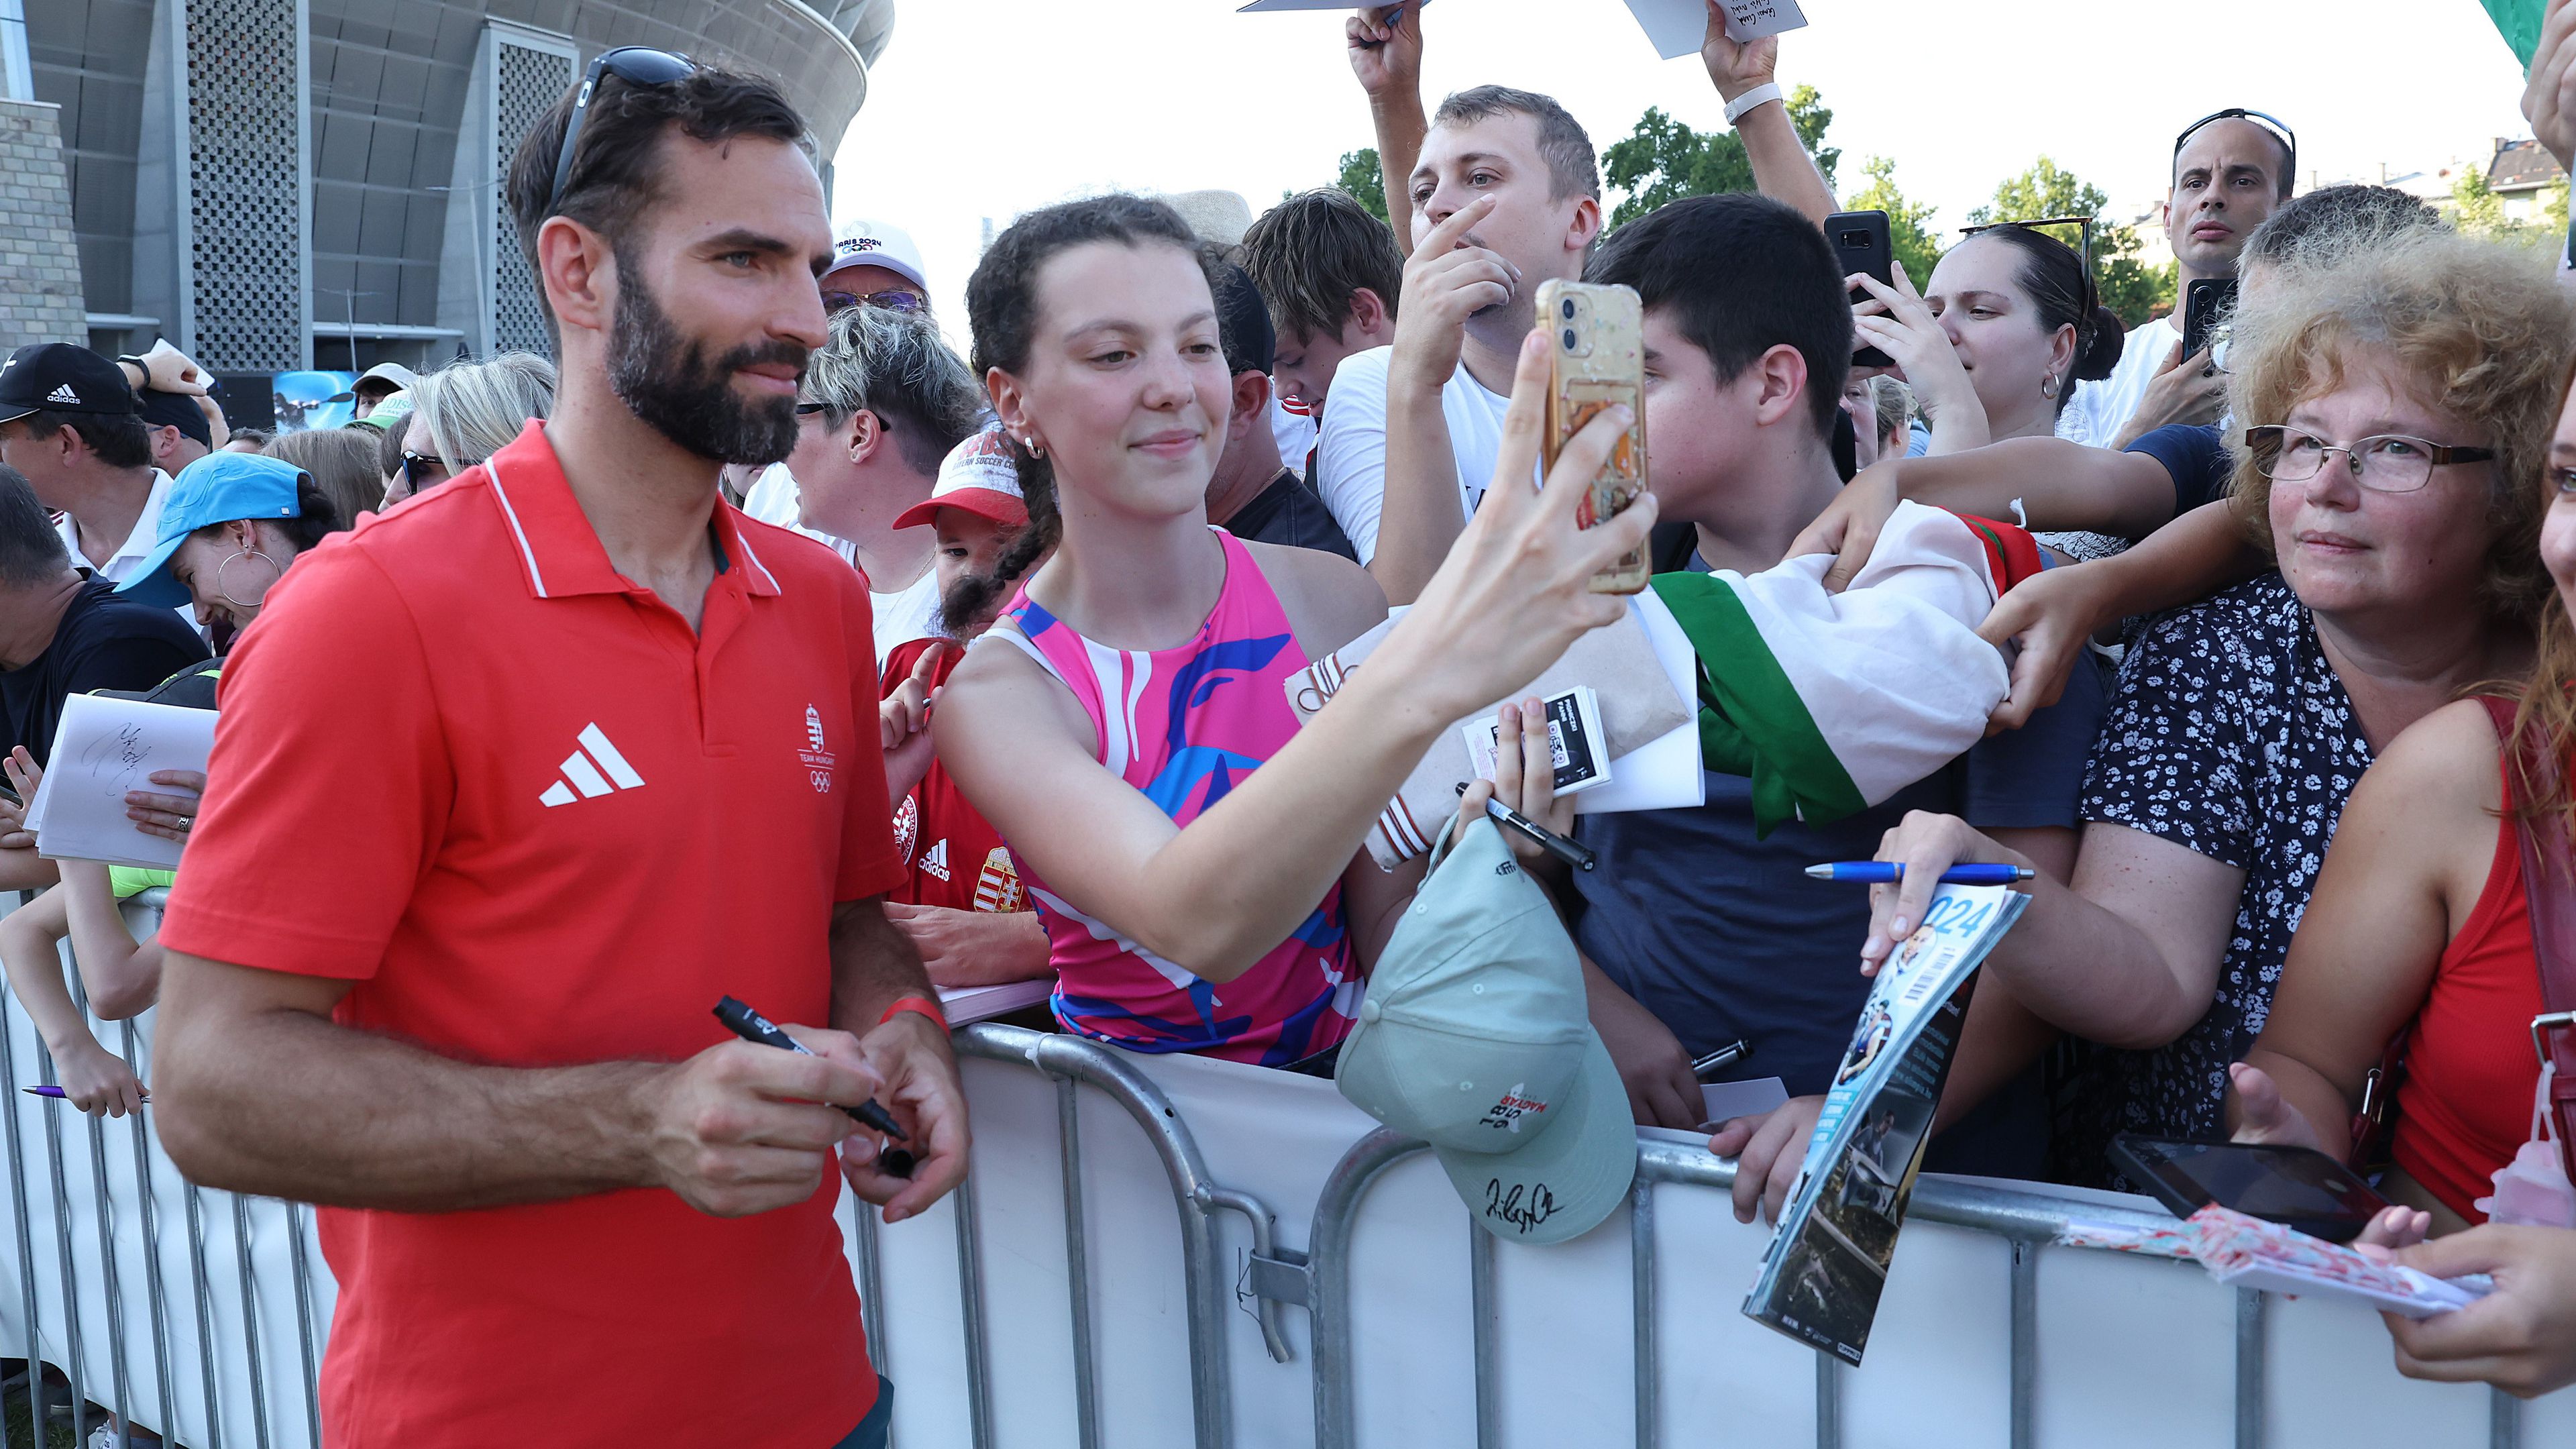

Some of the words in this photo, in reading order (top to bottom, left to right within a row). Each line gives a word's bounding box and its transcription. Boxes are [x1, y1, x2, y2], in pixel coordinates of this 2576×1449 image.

[859, 238, 881, 247] 2024
[47, 394, 80, 405] adidas
[975, 457, 1003, 467] SOCCER
[1004, 459, 1016, 470] CU
[800, 753, 814, 762] TEAM
[918, 858, 950, 882] adidas
[1921, 896, 1993, 938] 024
[1500, 1095, 1547, 1113] MAGYAR
